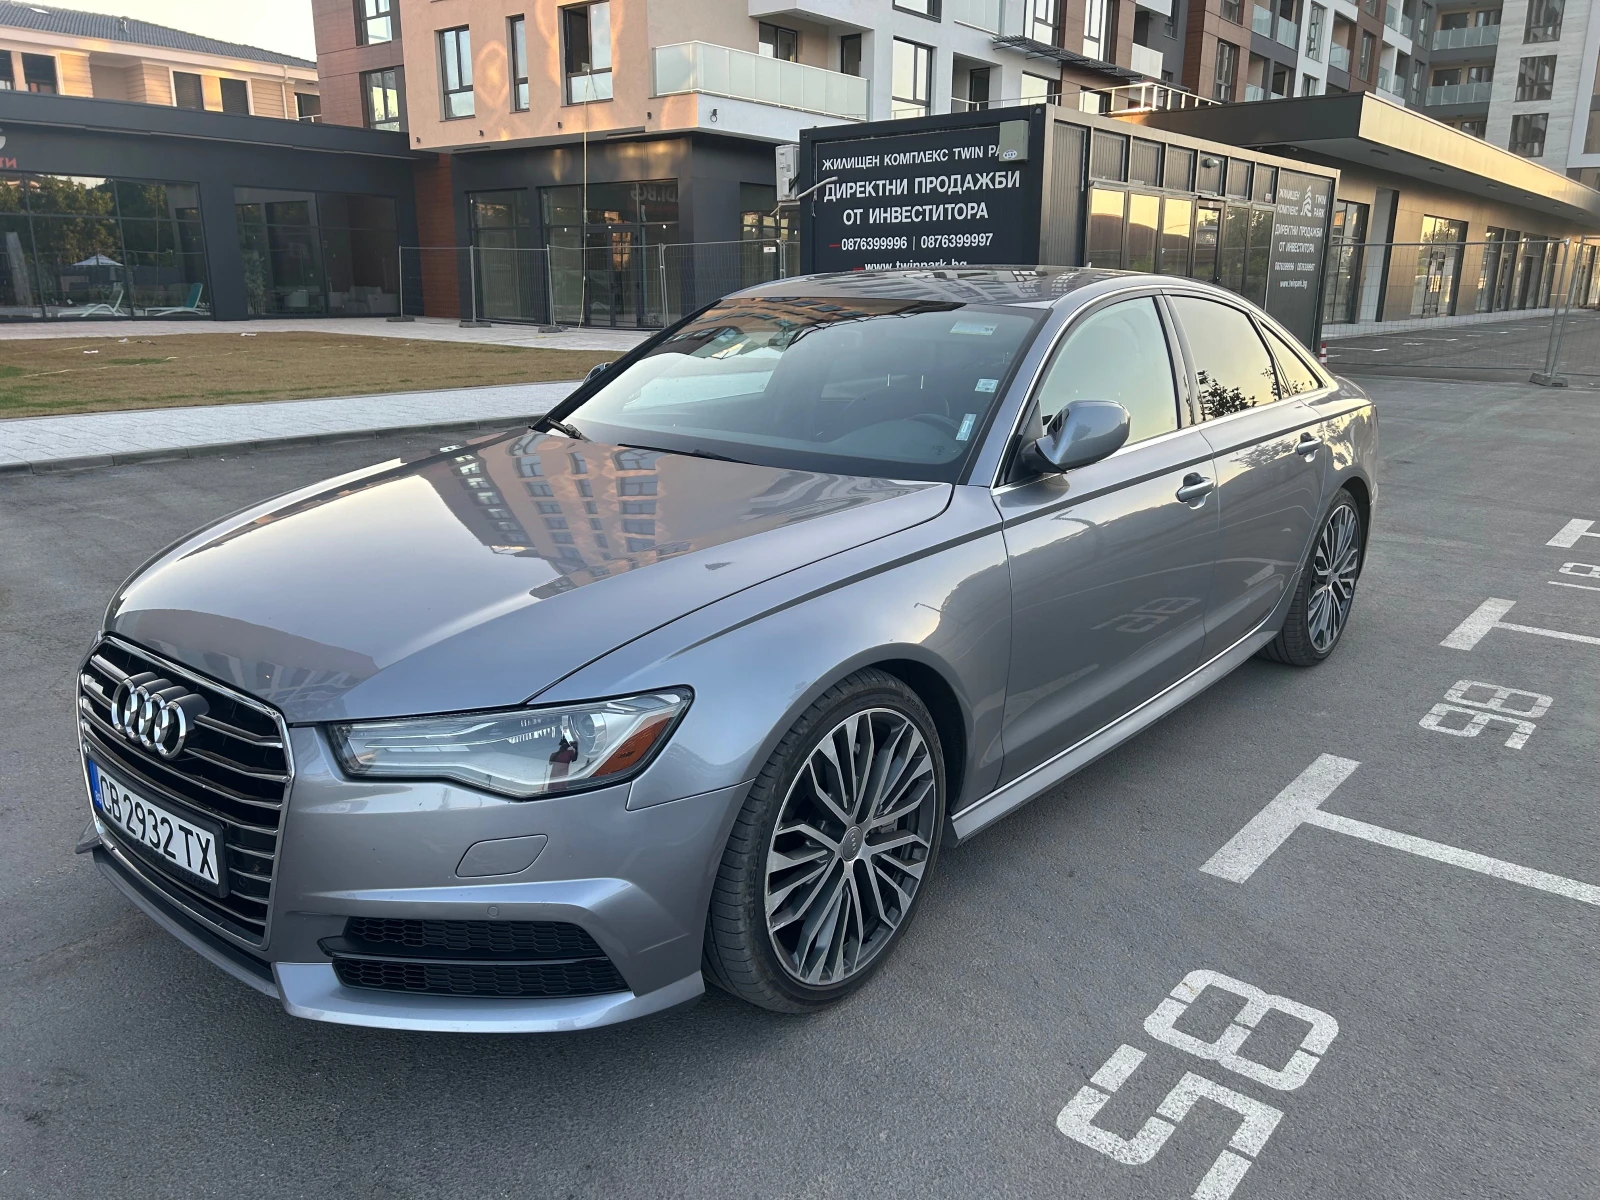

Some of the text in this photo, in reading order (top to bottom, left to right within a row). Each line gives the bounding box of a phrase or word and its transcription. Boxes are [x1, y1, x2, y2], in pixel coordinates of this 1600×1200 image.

[822, 155, 880, 170] ЖИЛИЩЕН
[884, 149, 949, 166] КОМПЛЕКС
[953, 146, 984, 161] TWIN
[988, 144, 1001, 157] PA
[824, 170, 1020, 202] ДИРЕКТНИ ПРОДАЖБИ
[843, 202, 989, 225] ОТ ИНВЕСТИТОРА
[841, 232, 993, 251] 0876399996 0876399997
[1279, 242, 1286, 252] ОТ
[864, 258, 967, 271] wwwtwinarkb
